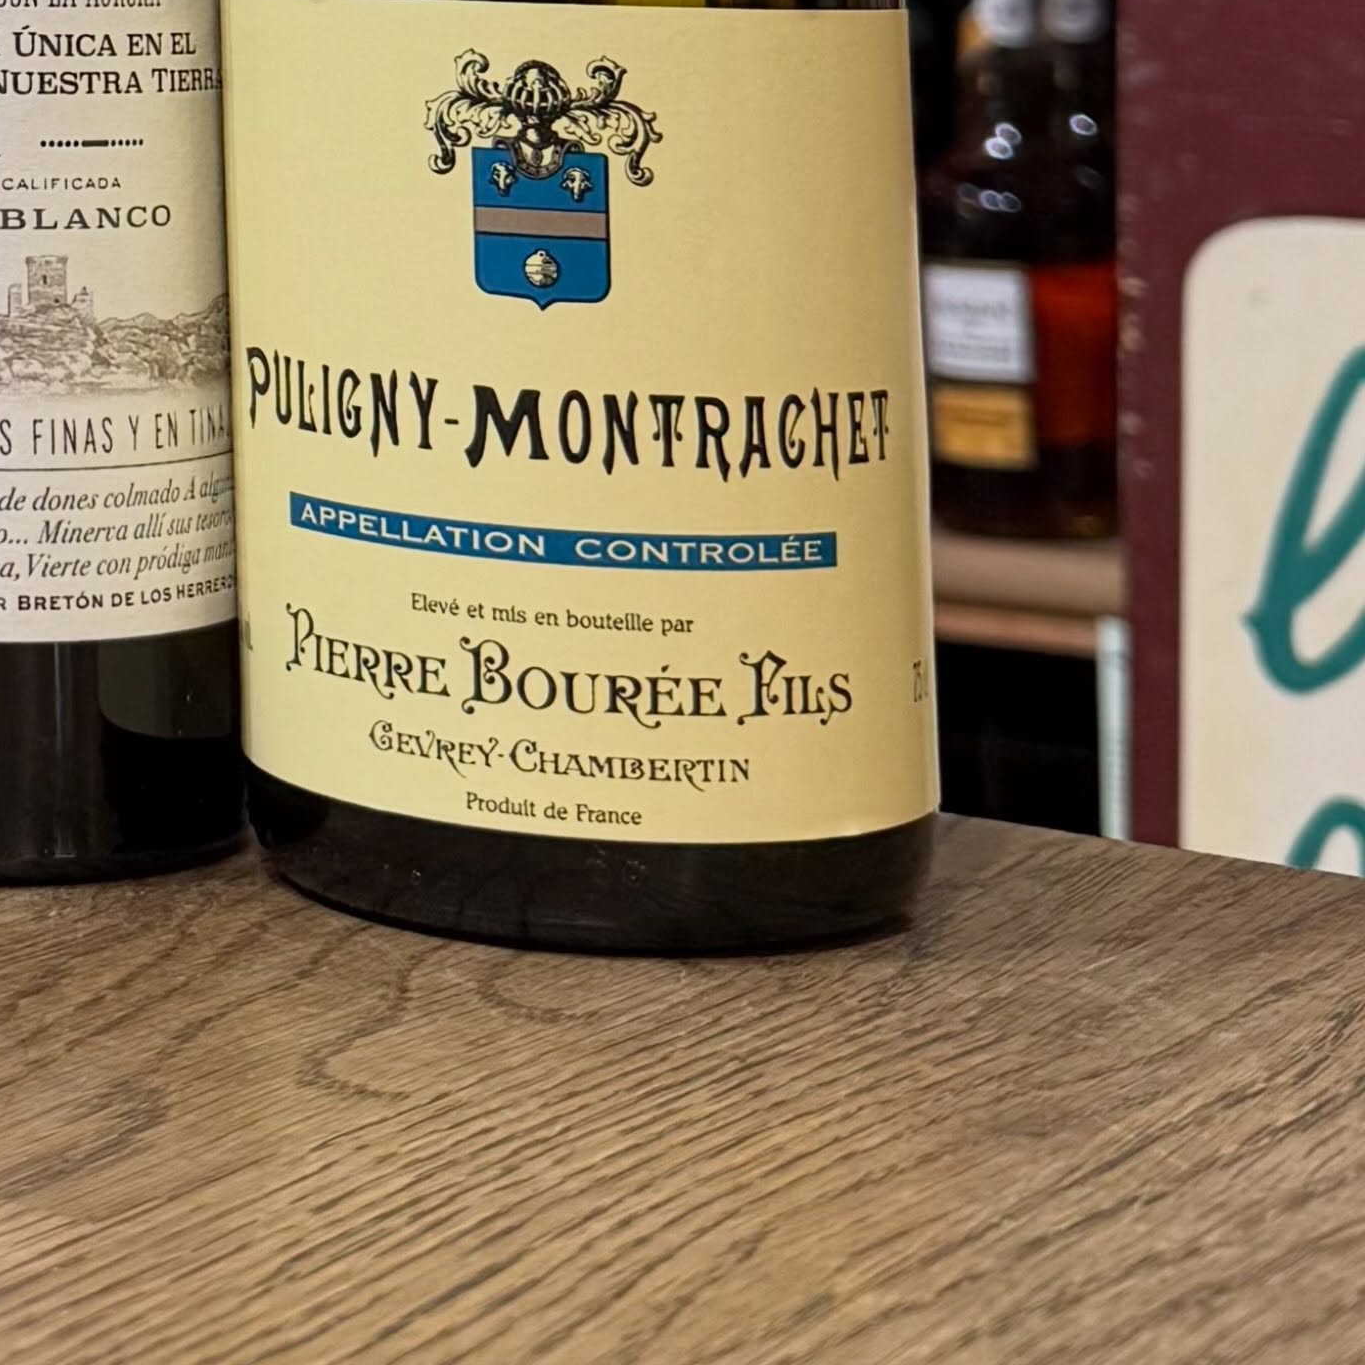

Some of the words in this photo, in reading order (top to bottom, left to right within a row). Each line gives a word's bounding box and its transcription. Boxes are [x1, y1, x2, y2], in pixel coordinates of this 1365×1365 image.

[14, 23, 117, 58] ÚNICA
[127, 32, 163, 57] EN
[170, 31, 197, 56] EL
[1, 176, 122, 190] CALIFICADA
[0, 205, 171, 231] BLANCO
[245, 345, 890, 483] PULIGNY-MONTRACHET
[32, 416, 113, 455] FINAS
[128, 415, 139, 451] Y
[155, 411, 179, 449] EN
[32, 487, 98, 512] dones
[103, 478, 180, 509] colmado
[37, 519, 127, 545] Minerva
[133, 512, 167, 539] allí
[167, 516, 193, 536] sus
[300, 501, 547, 559] APPELLATION
[574, 533, 825, 567] CONTROLÉE
[27, 552, 91, 578] Vierte
[96, 560, 133, 577] con
[133, 542, 200, 580] pródiga
[18, 591, 103, 611] BRETÓN
[111, 592, 134, 607] DE
[141, 587, 172, 605] LOS
[411, 592, 460, 617] Elevé
[466, 601, 486, 619] et
[492, 605, 527, 625] mis
[535, 610, 560, 627] en
[566, 609, 654, 634] bouteille
[661, 617, 694, 636] par
[285, 602, 452, 700] PIERRE
[459, 635, 727, 729] BOURÉE
[737, 649, 853, 726] FILS
[369, 719, 750, 793] GEVREY-CHAMBERTIN
[466, 791, 537, 819] Produit
[543, 801, 568, 821] de
[576, 803, 642, 827] France
